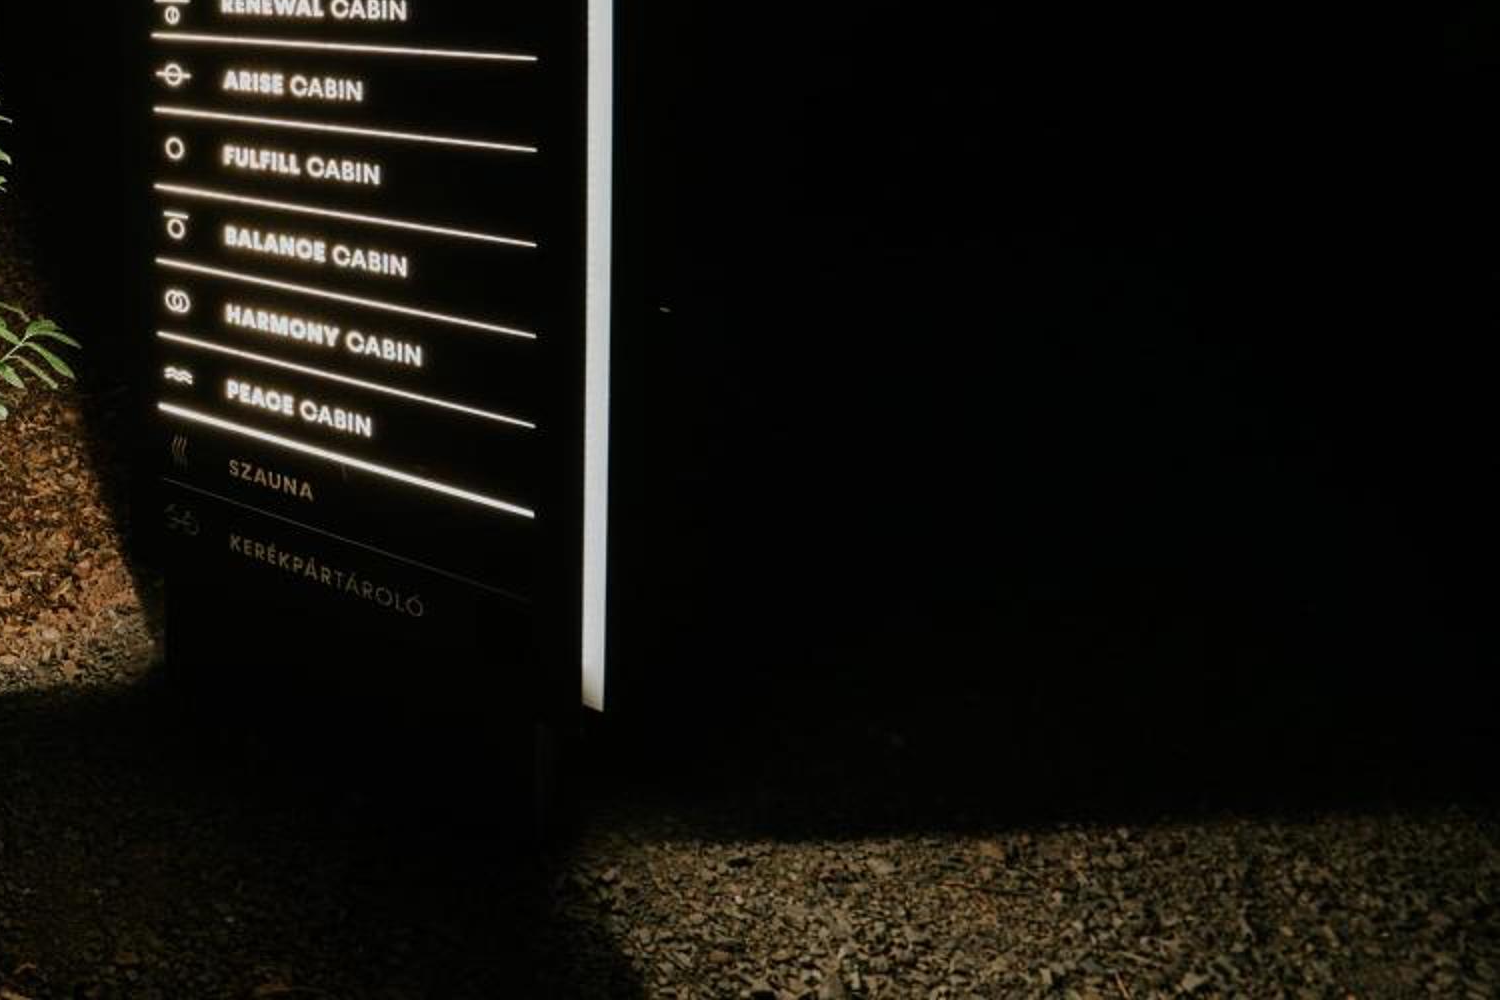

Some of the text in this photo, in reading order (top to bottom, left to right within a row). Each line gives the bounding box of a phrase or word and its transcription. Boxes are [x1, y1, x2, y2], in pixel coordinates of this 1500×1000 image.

[222, 69, 364, 102] ARISE CABIN
[222, 145, 381, 186] FULFILL CABIN
[223, 225, 409, 278] BALANCE CABIN
[224, 303, 423, 367] HARMONY CABIN
[226, 380, 373, 437] PEACE CABIN
[228, 458, 314, 500] SZAUNA
[229, 534, 425, 617] KERÉKPÁRTÁROLÓ
